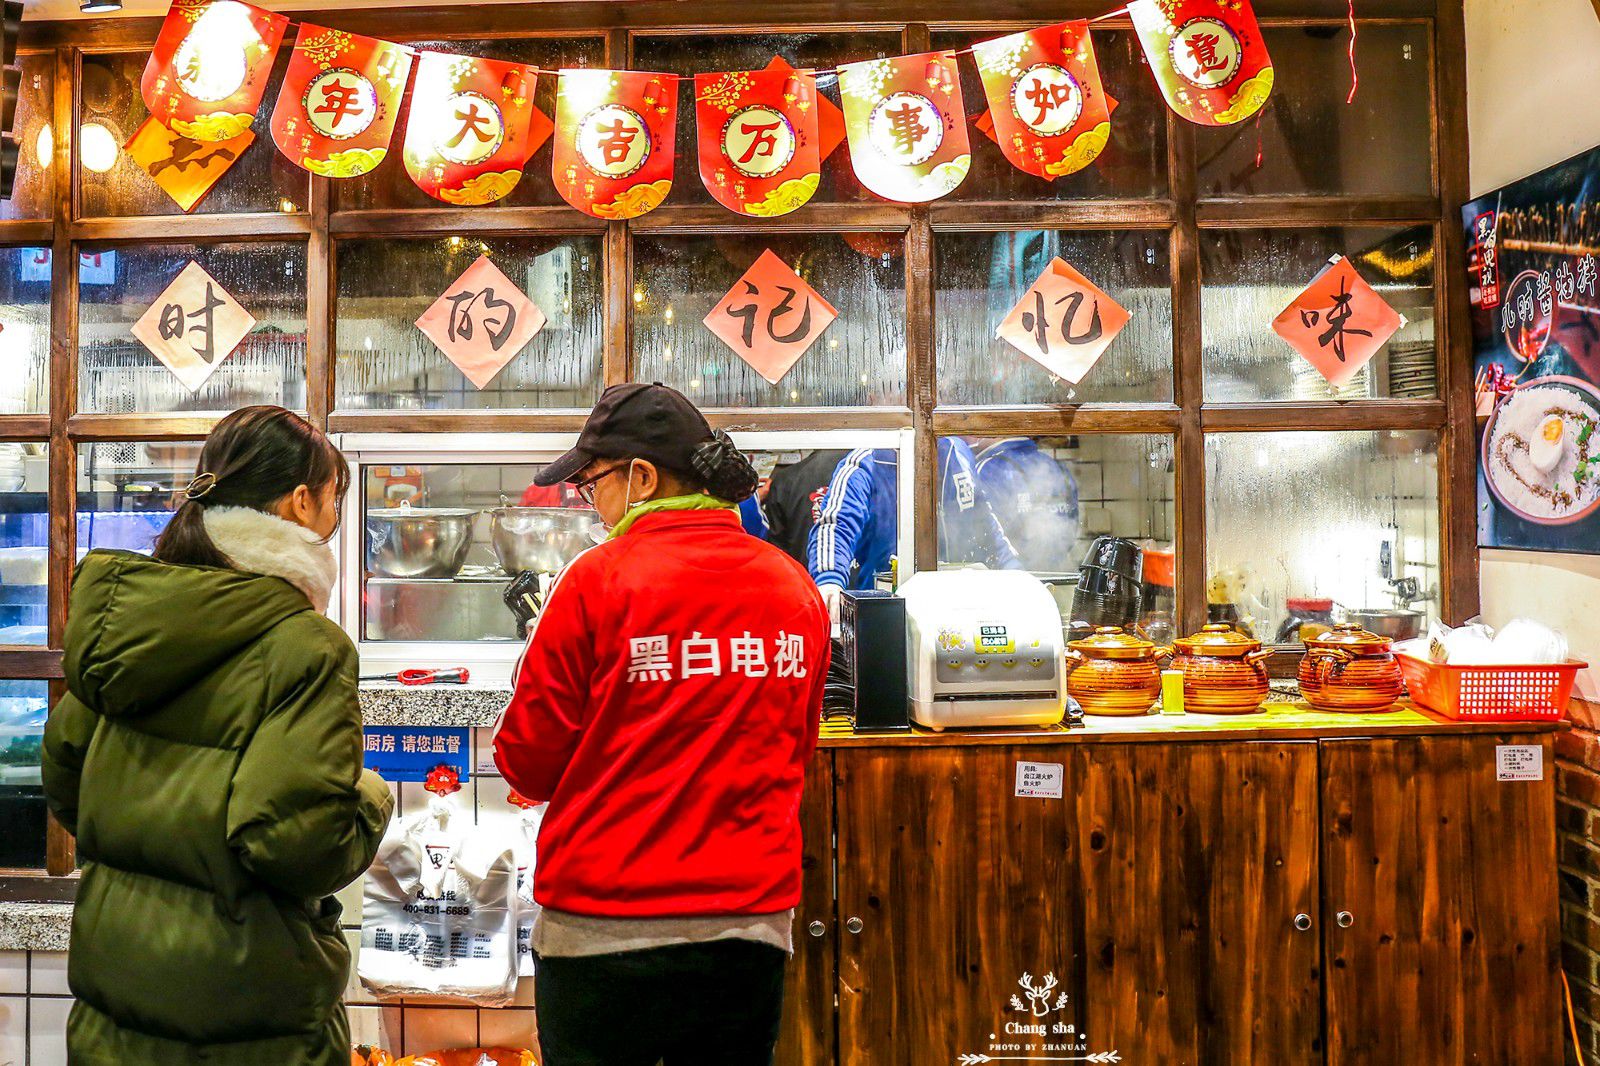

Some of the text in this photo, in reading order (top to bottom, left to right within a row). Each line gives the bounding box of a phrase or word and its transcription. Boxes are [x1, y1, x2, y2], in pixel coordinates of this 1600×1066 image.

[314, 78, 364, 128] 年
[447, 104, 495, 148] 大
[595, 119, 639, 166] 吉
[737, 120, 781, 163] 万
[885, 103, 930, 155] 事
[1025, 78, 1071, 126] 如
[1185, 32, 1228, 79] 意
[1478, 217, 1496, 285] 黑白电视
[158, 275, 1373, 364] 时 的 记 忆 味
[626, 630, 808, 683] 黑白电视
[363, 734, 461, 753] 厨房 请您监督
[402, 904, 470, 916] 400-831-6689
